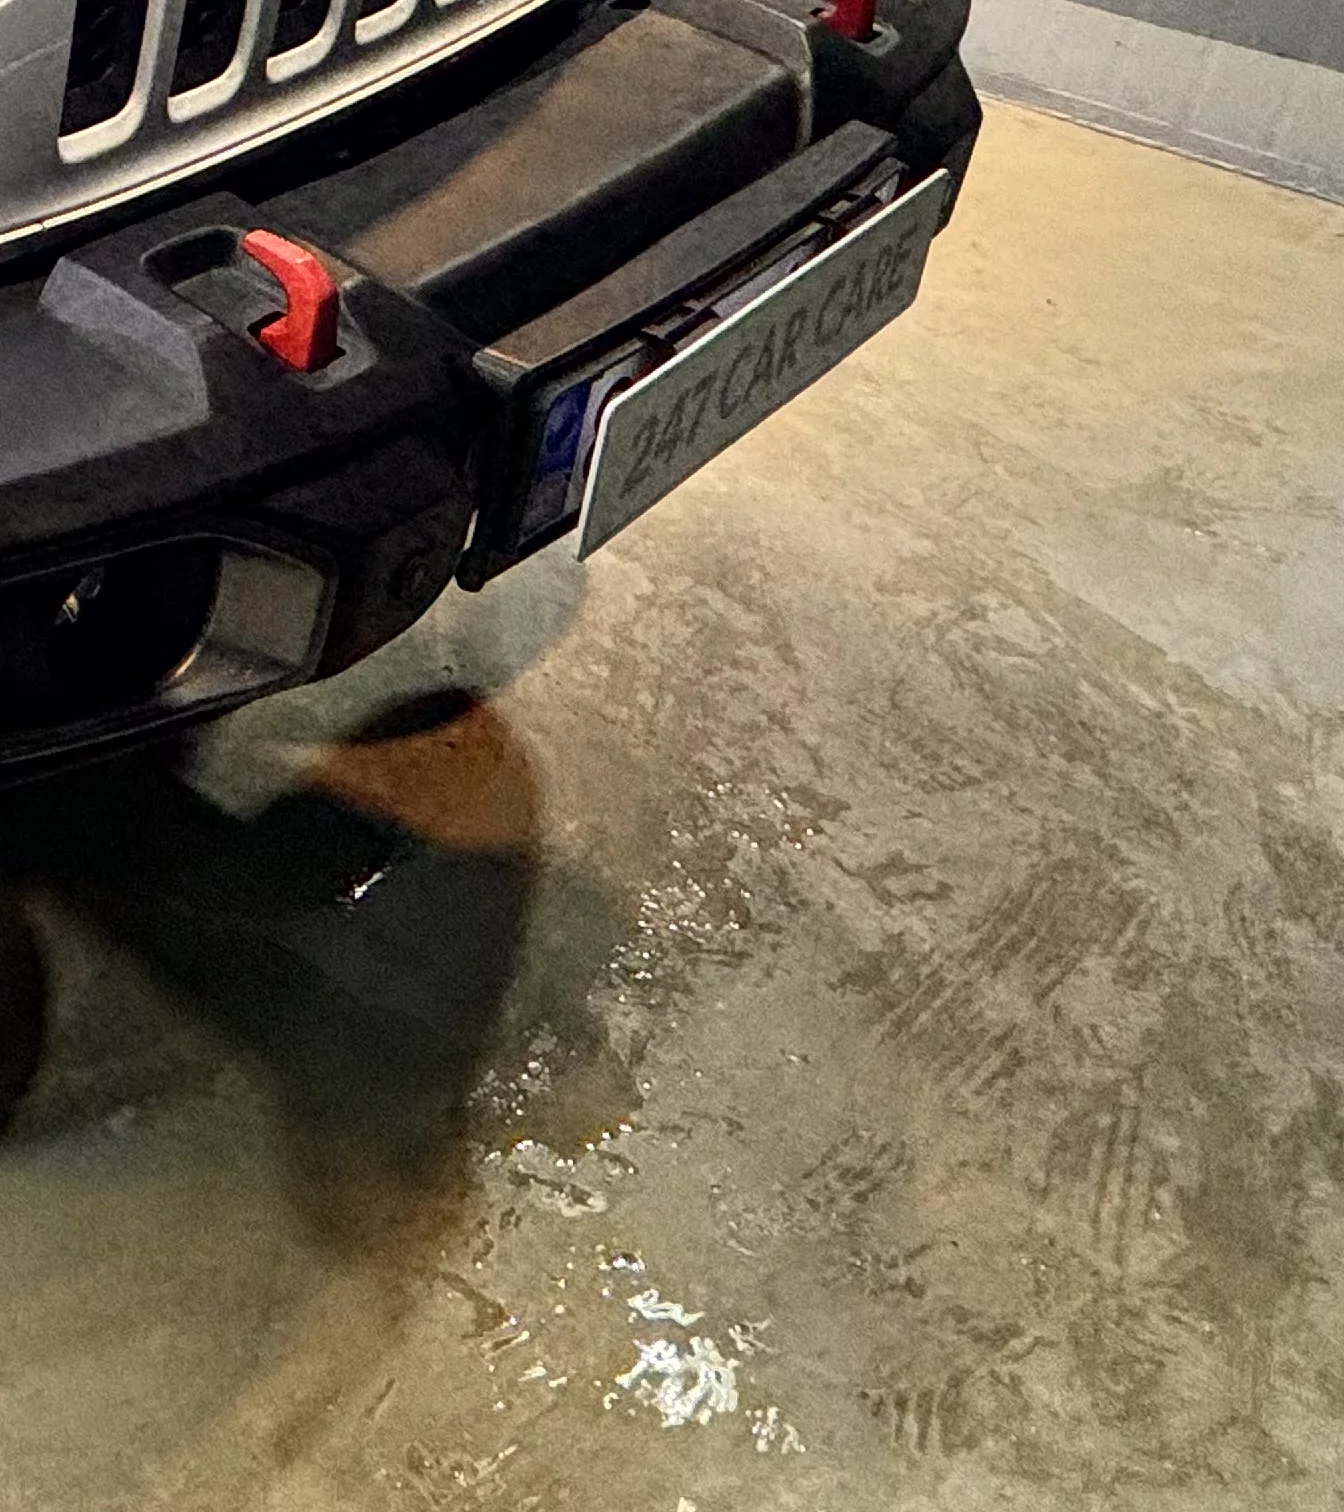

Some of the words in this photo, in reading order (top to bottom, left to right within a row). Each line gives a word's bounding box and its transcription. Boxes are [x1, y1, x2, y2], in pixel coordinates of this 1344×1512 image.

[619, 370, 717, 499] 247
[719, 310, 808, 419] CAR
[814, 224, 918, 346] CARE
